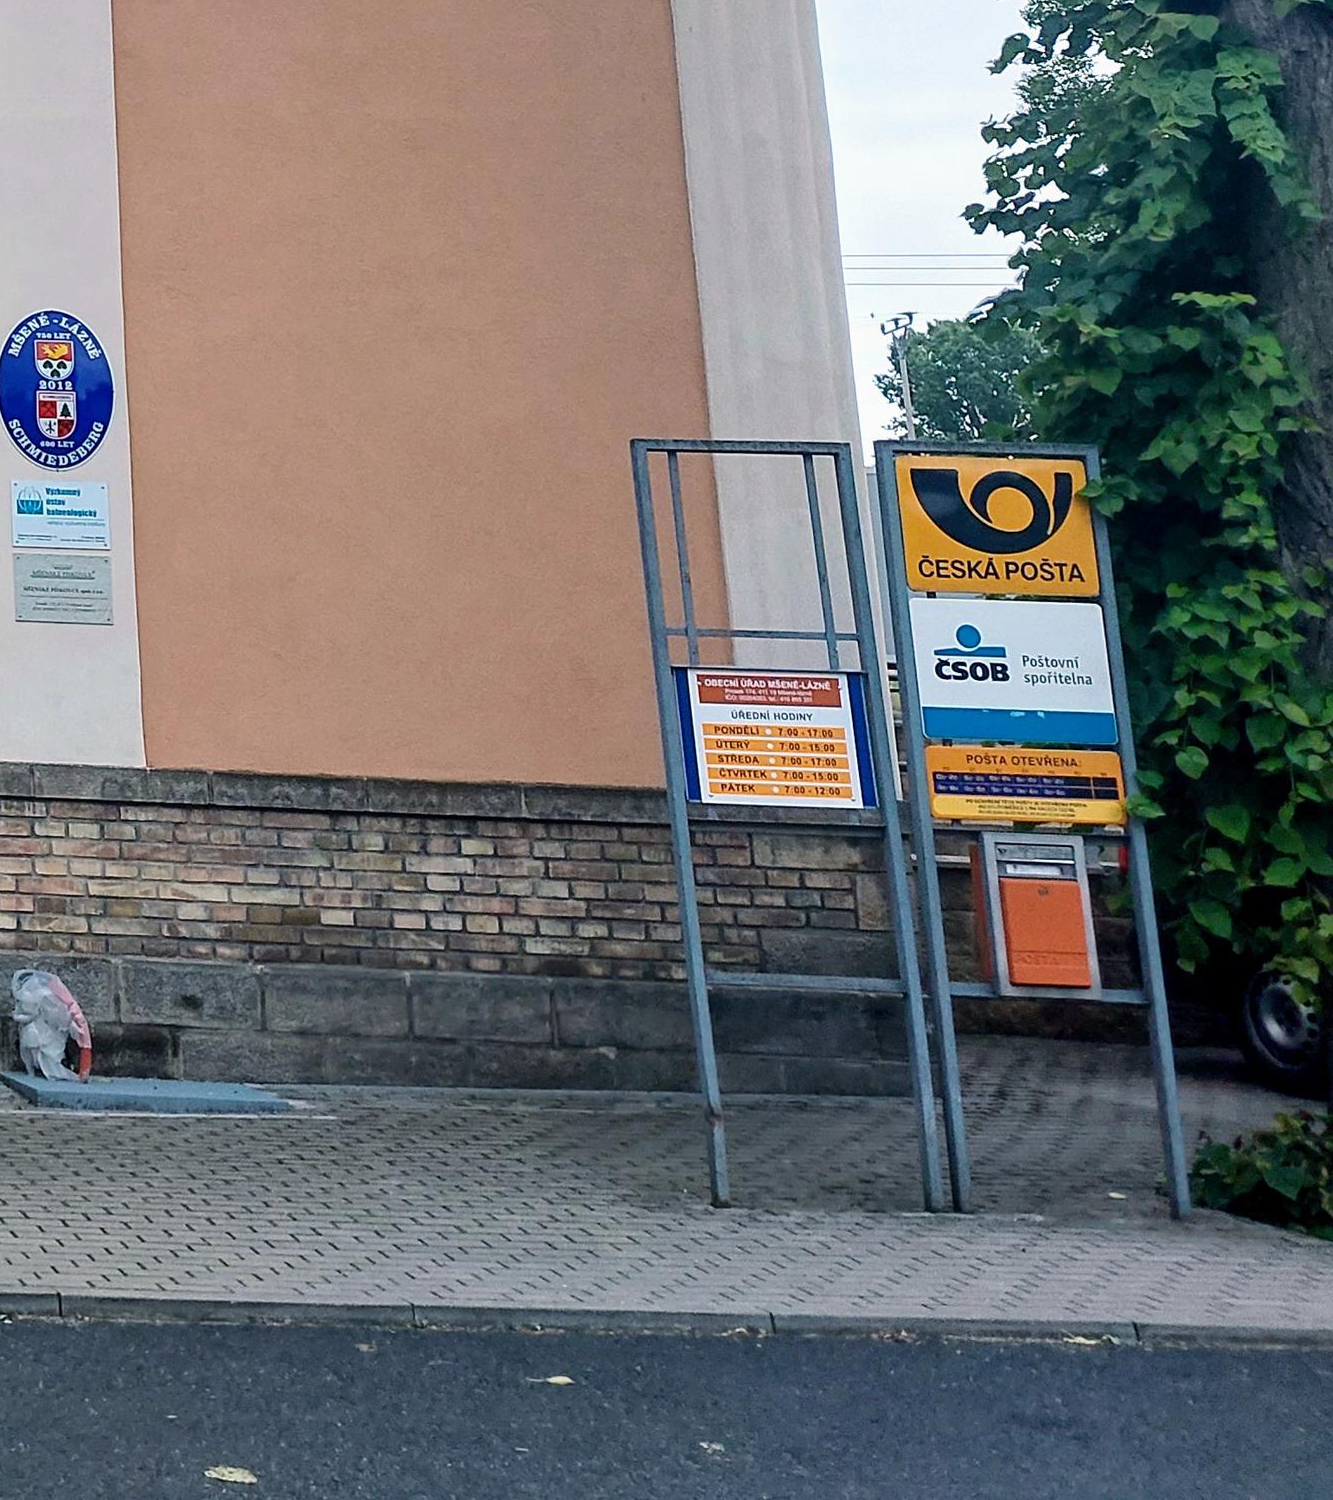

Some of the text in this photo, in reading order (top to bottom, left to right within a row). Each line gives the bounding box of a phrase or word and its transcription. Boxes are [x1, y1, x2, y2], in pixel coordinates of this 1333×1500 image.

[38, 380, 73, 390] 2012
[8, 418, 104, 467] SCHMIEDEBERG
[918, 555, 1086, 582] ČESKÁ POŠTA
[1022, 655, 1080, 670] Poštovní
[934, 657, 1011, 682] ČSOB
[704, 677, 739, 688] OBECNÍ
[740, 678, 766, 688] ÚŘAD
[1024, 669, 1093, 686] spořitelna
[730, 709, 814, 721] ÚŘEDNÍ HODINY
[714, 726, 760, 736] PONDĚLÍ
[778, 728, 798, 737] 7:00
[808, 729, 833, 738] 17:00
[716, 740, 750, 749] ÚTERÝ
[780, 742, 800, 751] 7:00
[810, 744, 835, 752] 15:00
[718, 754, 760, 764] STŘEDA
[781, 756, 802, 765] 7:00
[812, 758, 837, 766] 17:00
[966, 752, 1008, 766] POŠTA
[719, 768, 768, 778] ČTVRTEK
[782, 771, 804, 780] 7:00
[813, 772, 838, 781] 15:00
[720, 782, 756, 792] PÁTEK
[784, 785, 805, 794] 7:00
[814, 786, 840, 796] 12:00
